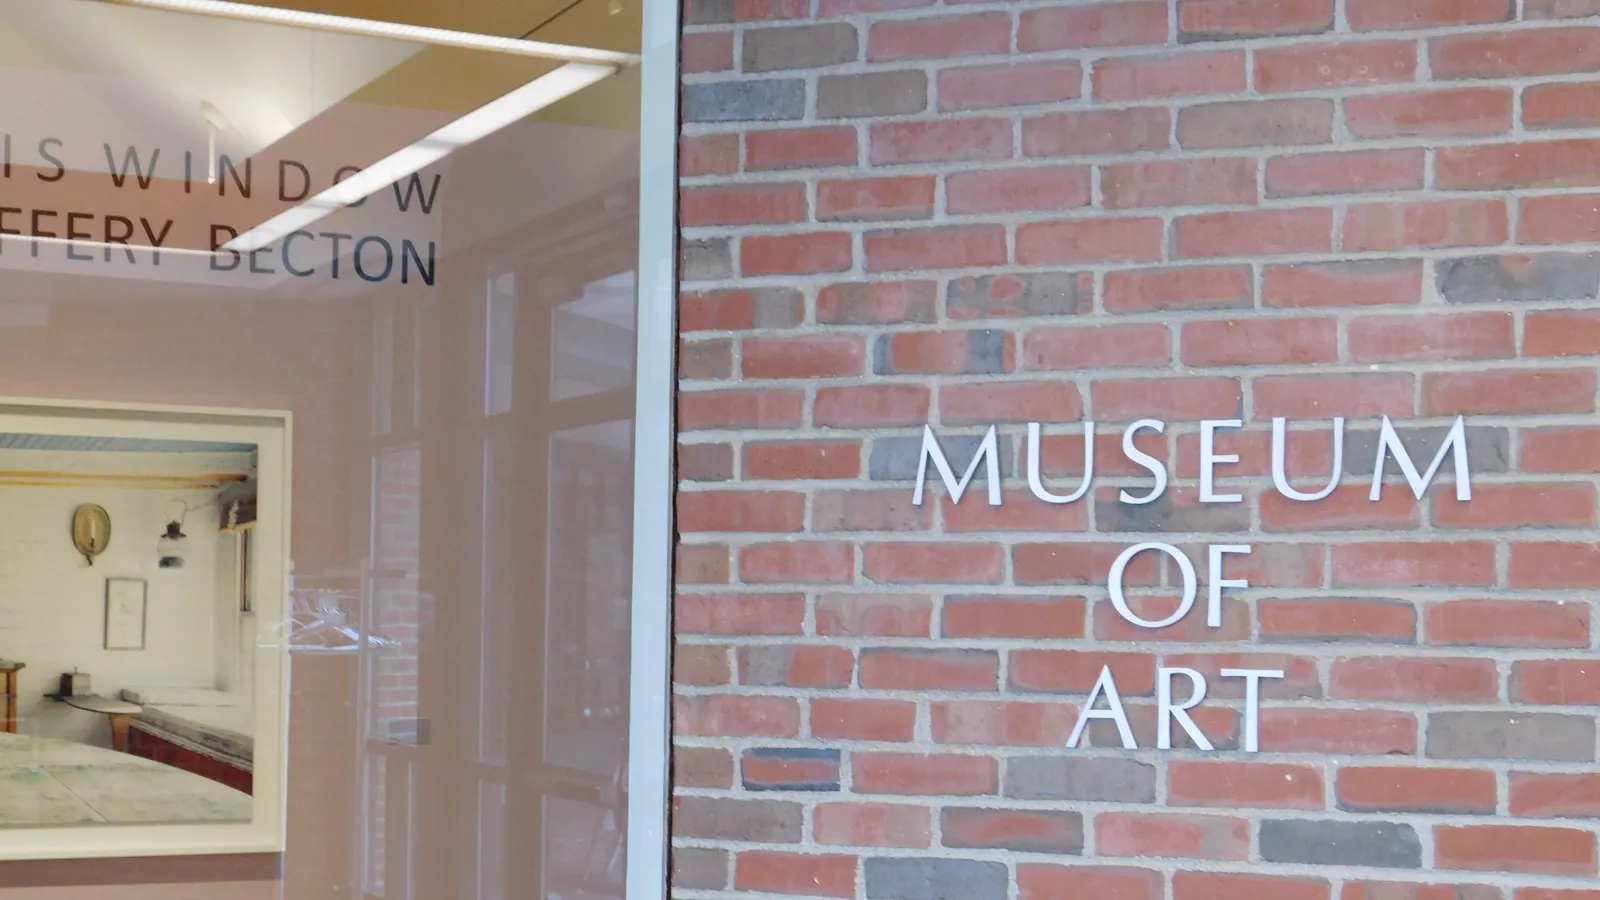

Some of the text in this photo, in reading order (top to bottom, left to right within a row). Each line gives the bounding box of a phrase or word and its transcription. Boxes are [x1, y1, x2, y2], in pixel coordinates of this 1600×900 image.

[4, 133, 441, 215] IS WINDOW
[209, 223, 436, 286] BECTON
[912, 415, 1472, 506] MUSEUM
[1107, 542, 1252, 628] OF
[1065, 664, 1285, 752] ART
